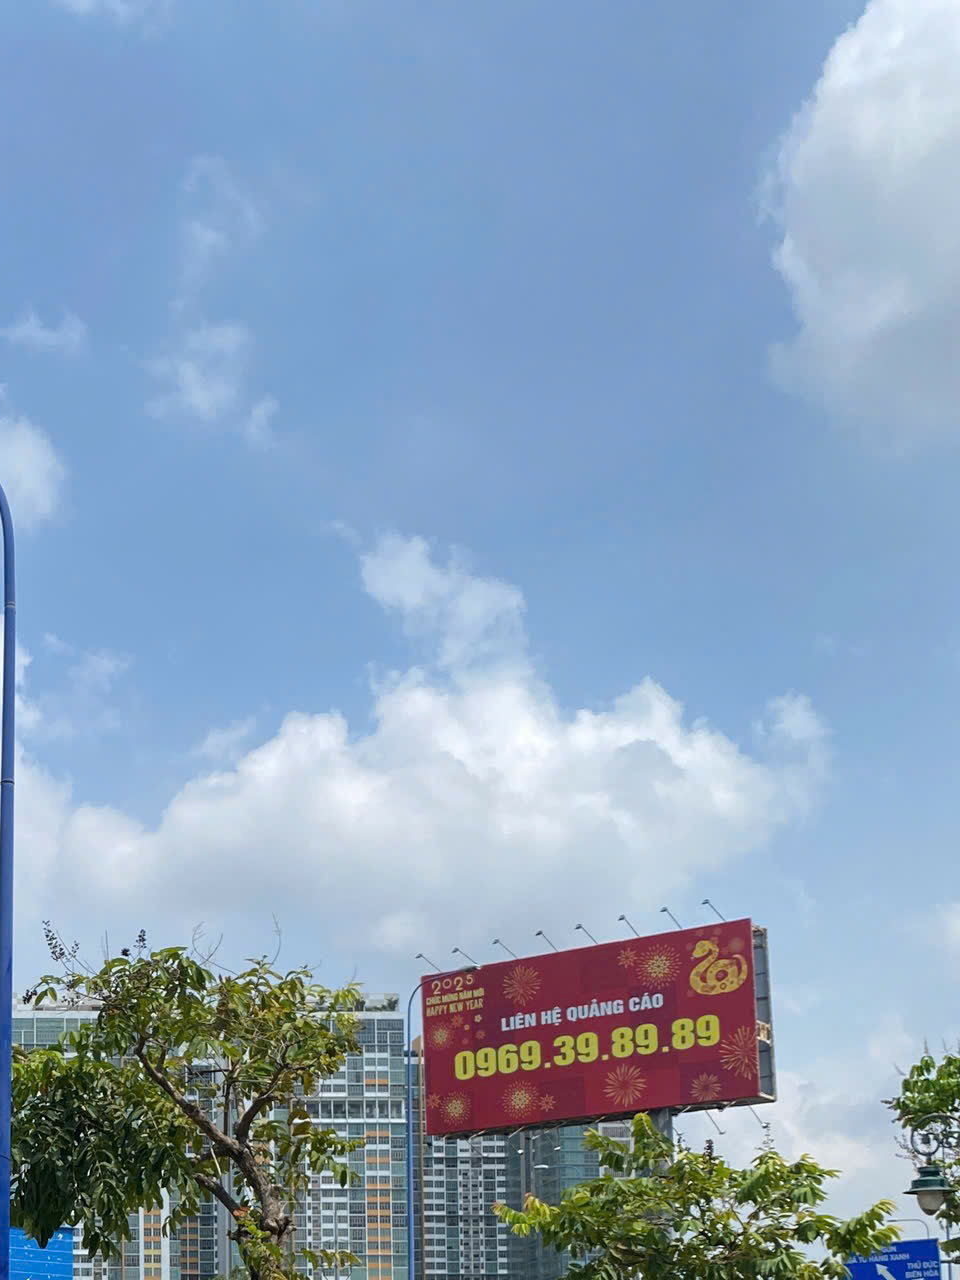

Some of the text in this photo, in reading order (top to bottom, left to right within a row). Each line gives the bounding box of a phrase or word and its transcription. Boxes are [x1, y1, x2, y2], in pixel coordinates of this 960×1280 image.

[431, 974, 474, 995] 2025
[426, 998, 484, 1016] HAPPY NEW YEAR
[501, 992, 664, 1032] LIÊN HỆ QUẢNG CÁO
[454, 1014, 721, 1081] 0969.39.89.89
[889, 1252, 910, 1261] XANH
